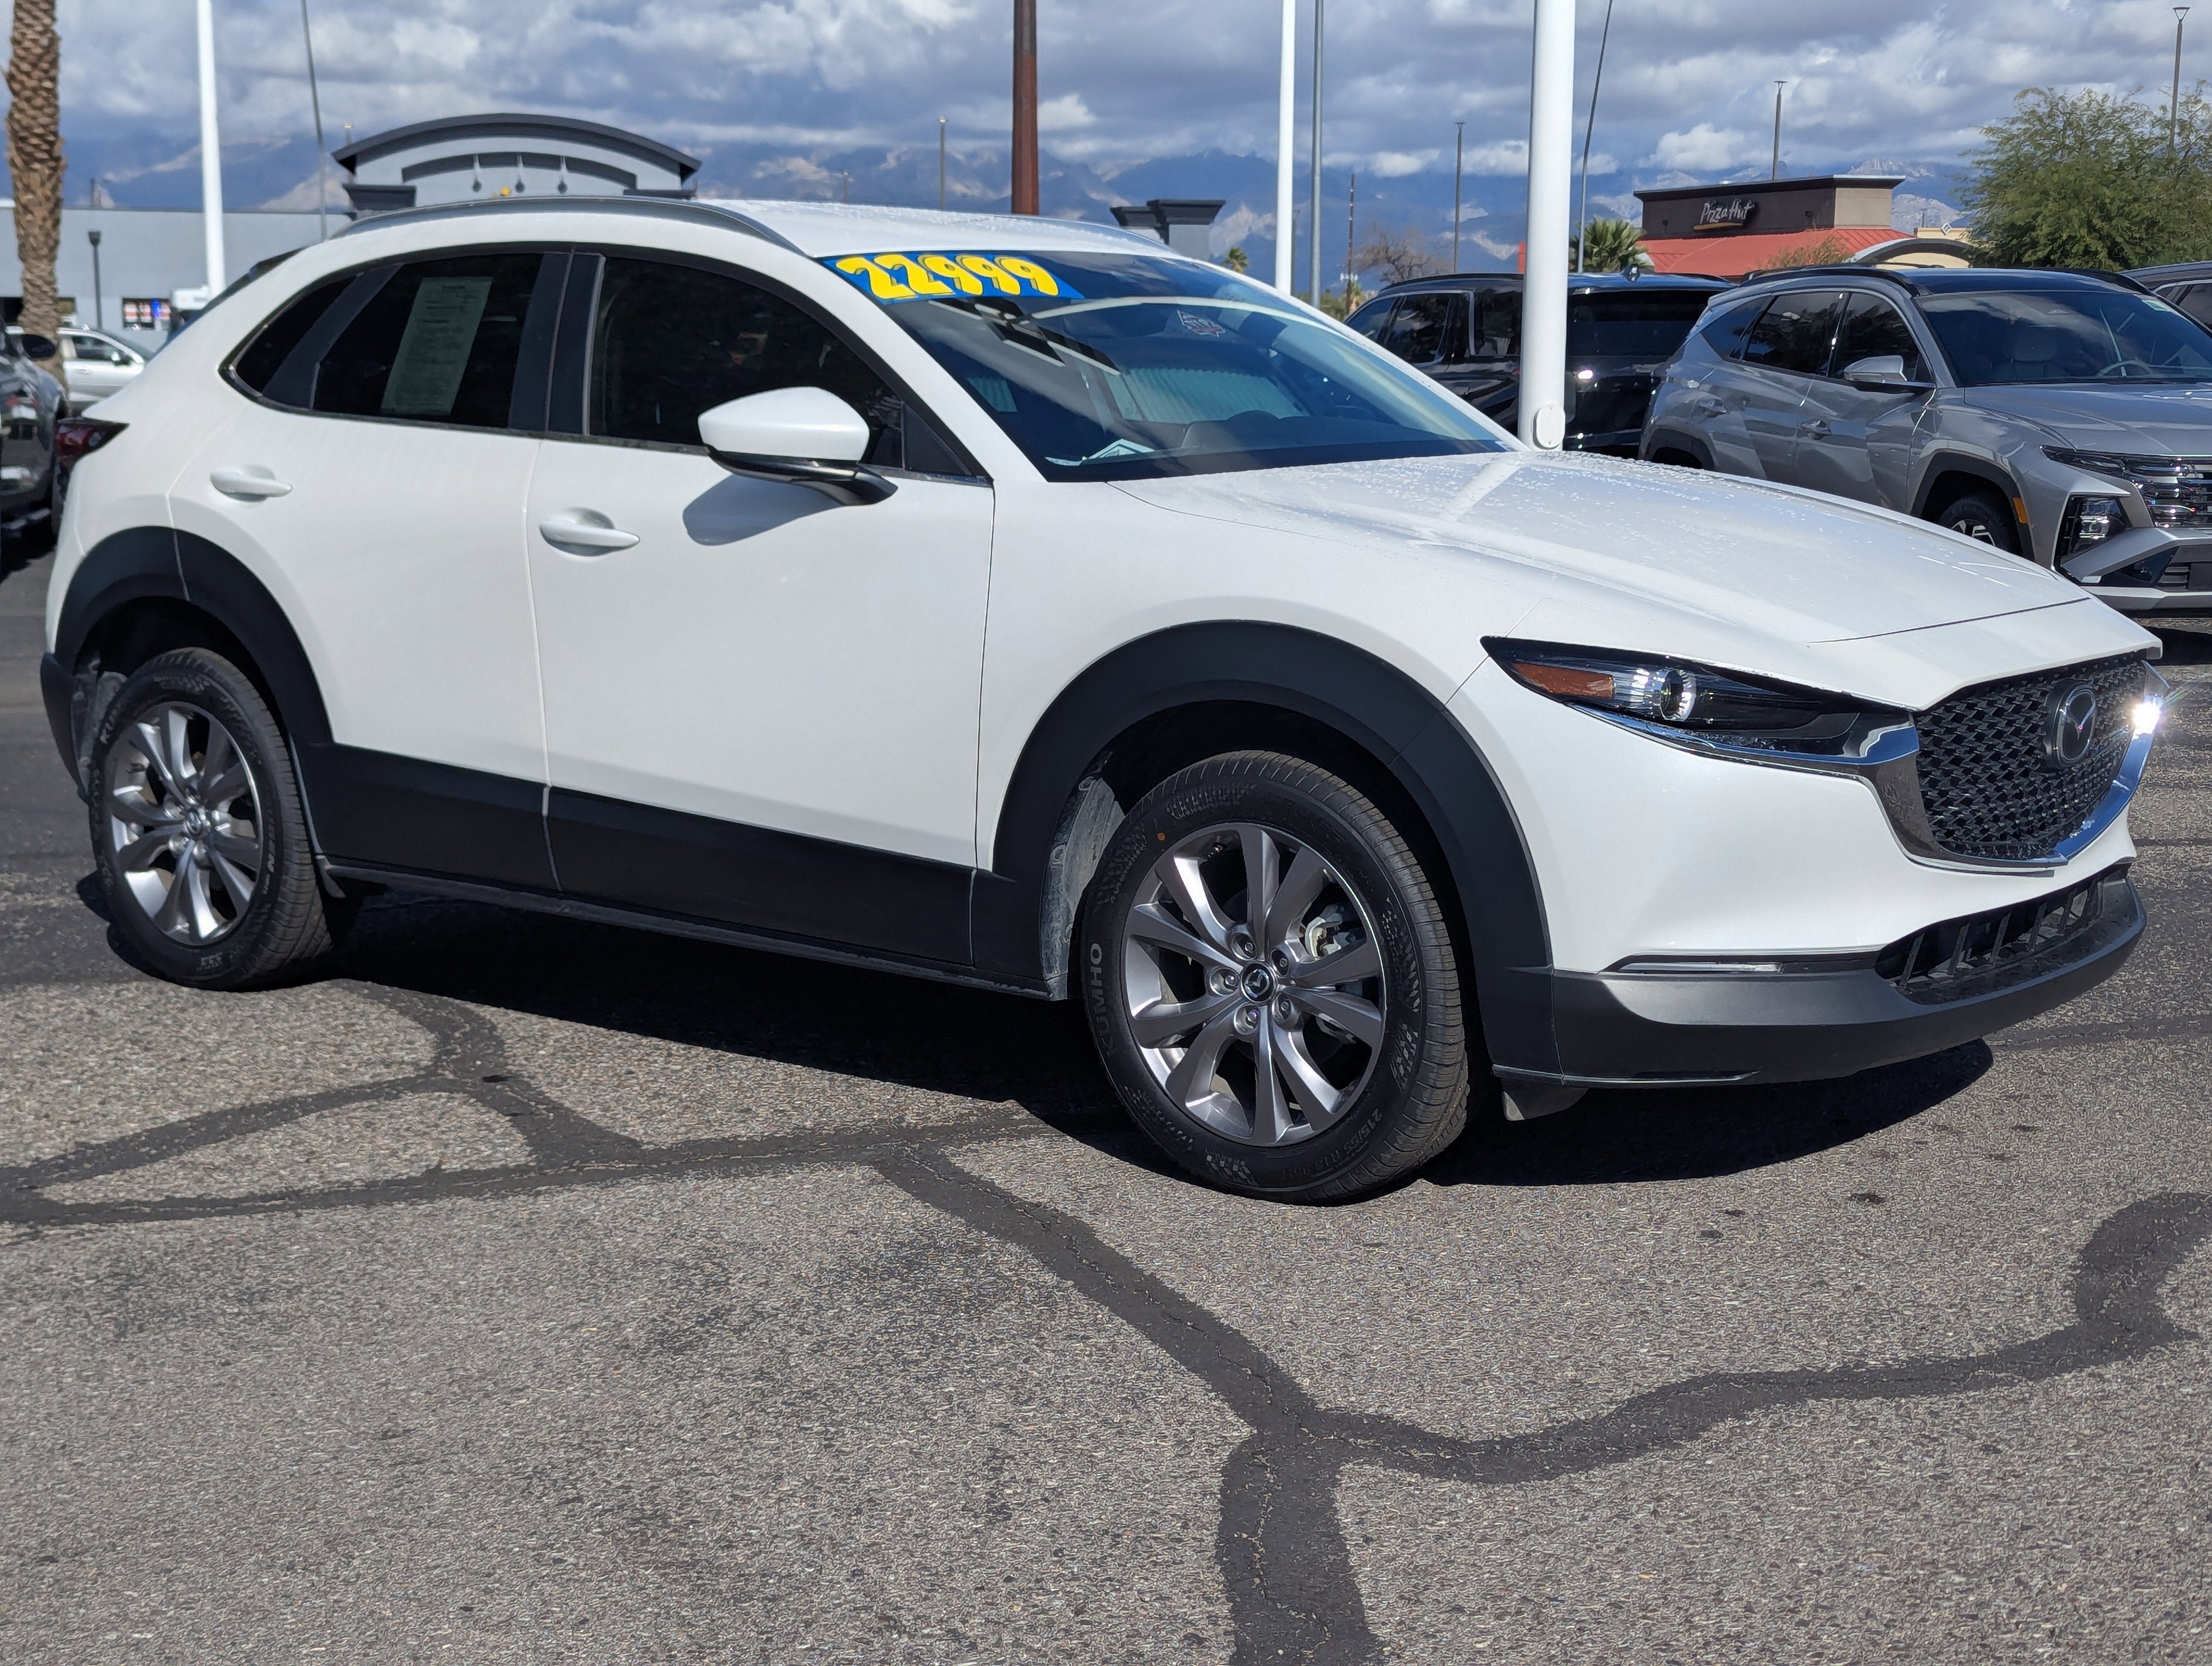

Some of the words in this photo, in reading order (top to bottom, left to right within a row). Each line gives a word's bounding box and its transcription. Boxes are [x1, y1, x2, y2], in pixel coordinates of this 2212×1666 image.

[1700, 201, 1728, 225] Pizza
[1728, 198, 1752, 220] Hut
[835, 254, 1059, 299] 22999
[1090, 943, 1117, 1058] KUMHO
[1343, 1108, 1382, 1154] 215/55
